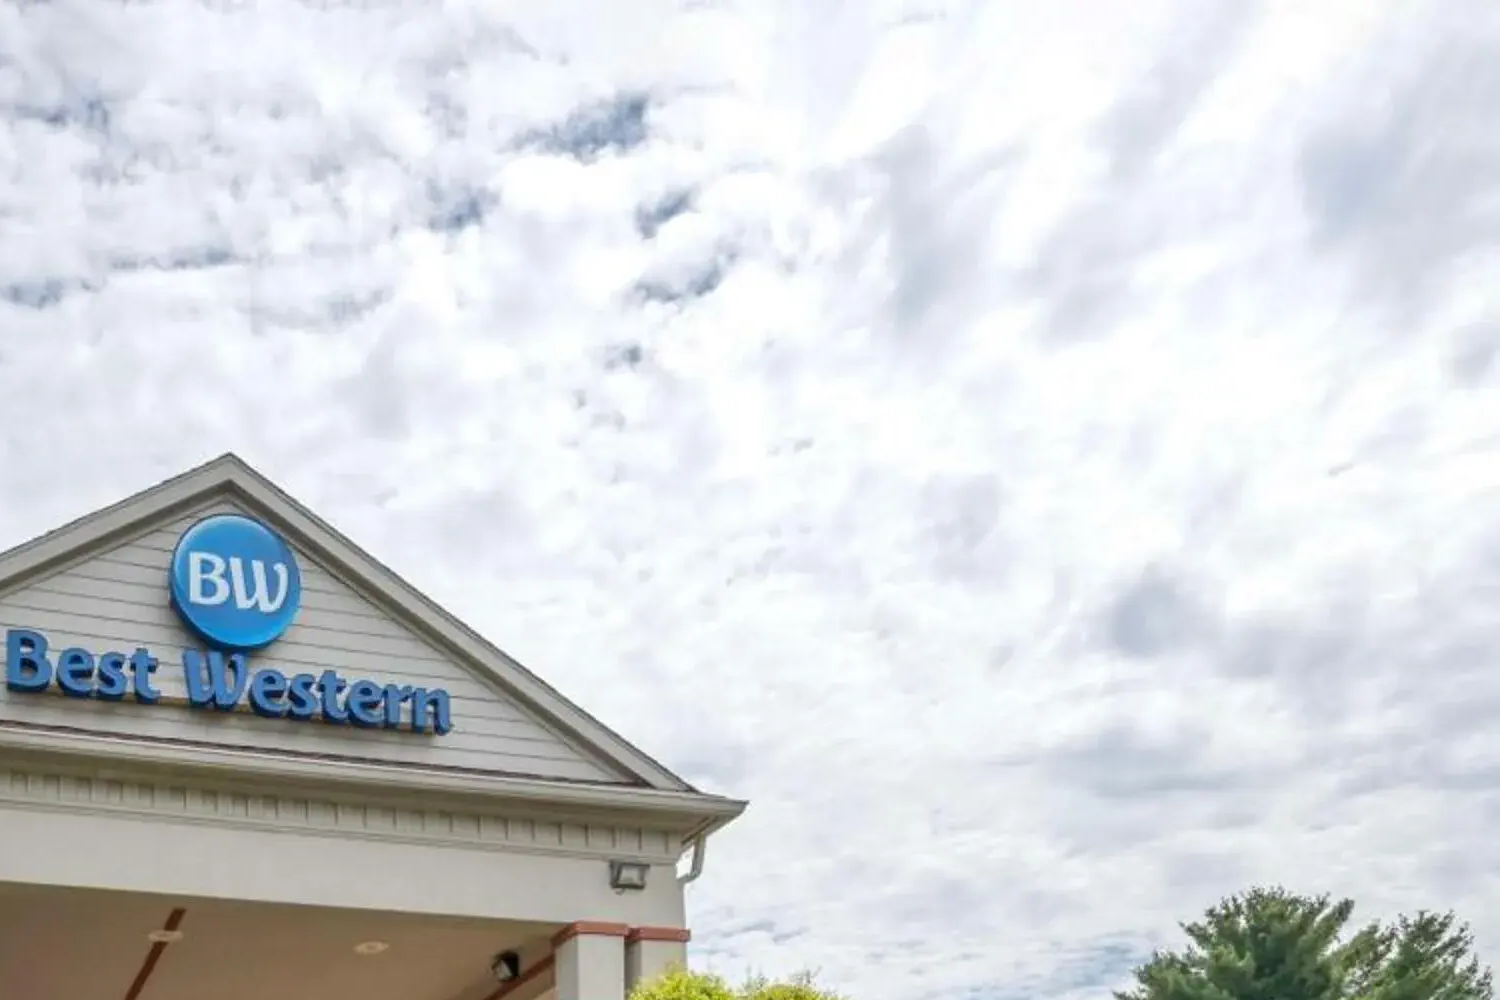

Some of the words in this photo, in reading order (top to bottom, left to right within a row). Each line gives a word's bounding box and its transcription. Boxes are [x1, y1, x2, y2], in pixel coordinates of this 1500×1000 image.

[188, 551, 289, 613] BW
[5, 628, 162, 701] Best
[182, 647, 453, 736] Western
